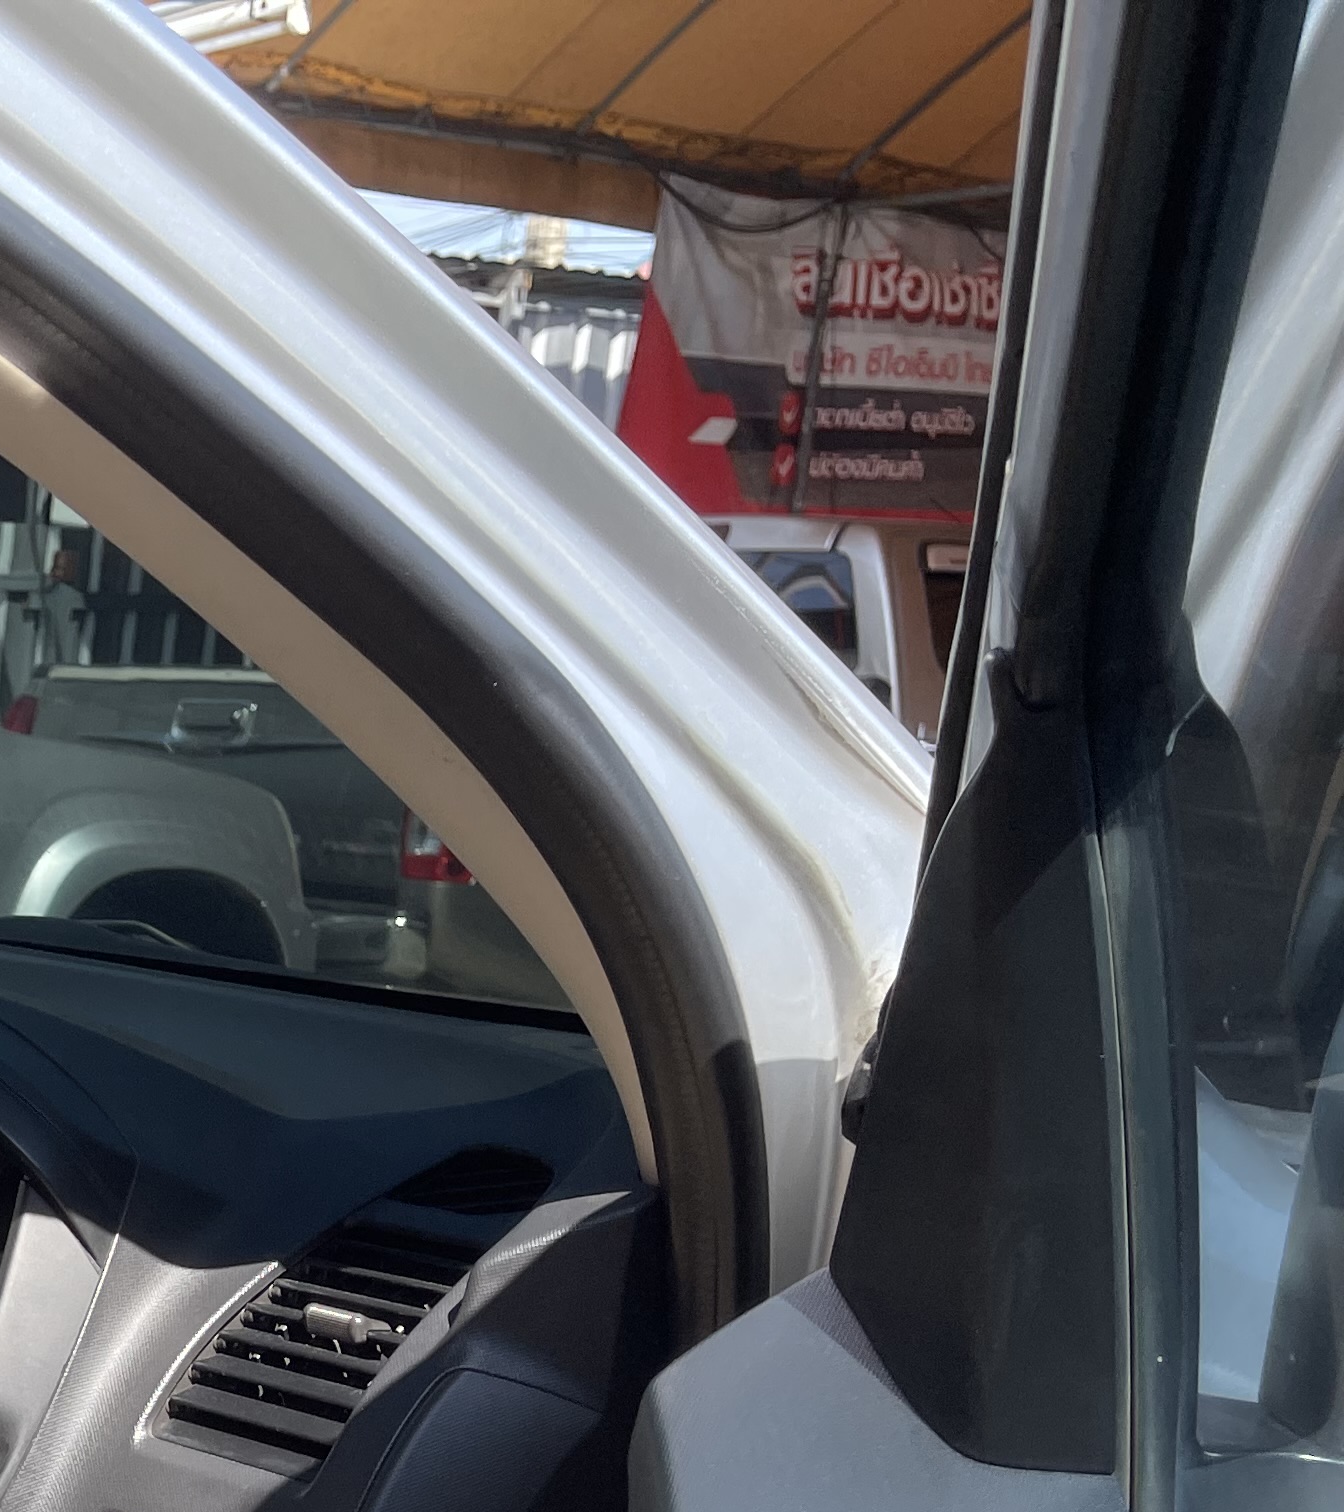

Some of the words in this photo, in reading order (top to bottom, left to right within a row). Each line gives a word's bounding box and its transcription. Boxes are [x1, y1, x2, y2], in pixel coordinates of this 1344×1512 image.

[791, 242, 1002, 331] สินเชื่อเช่าซื
